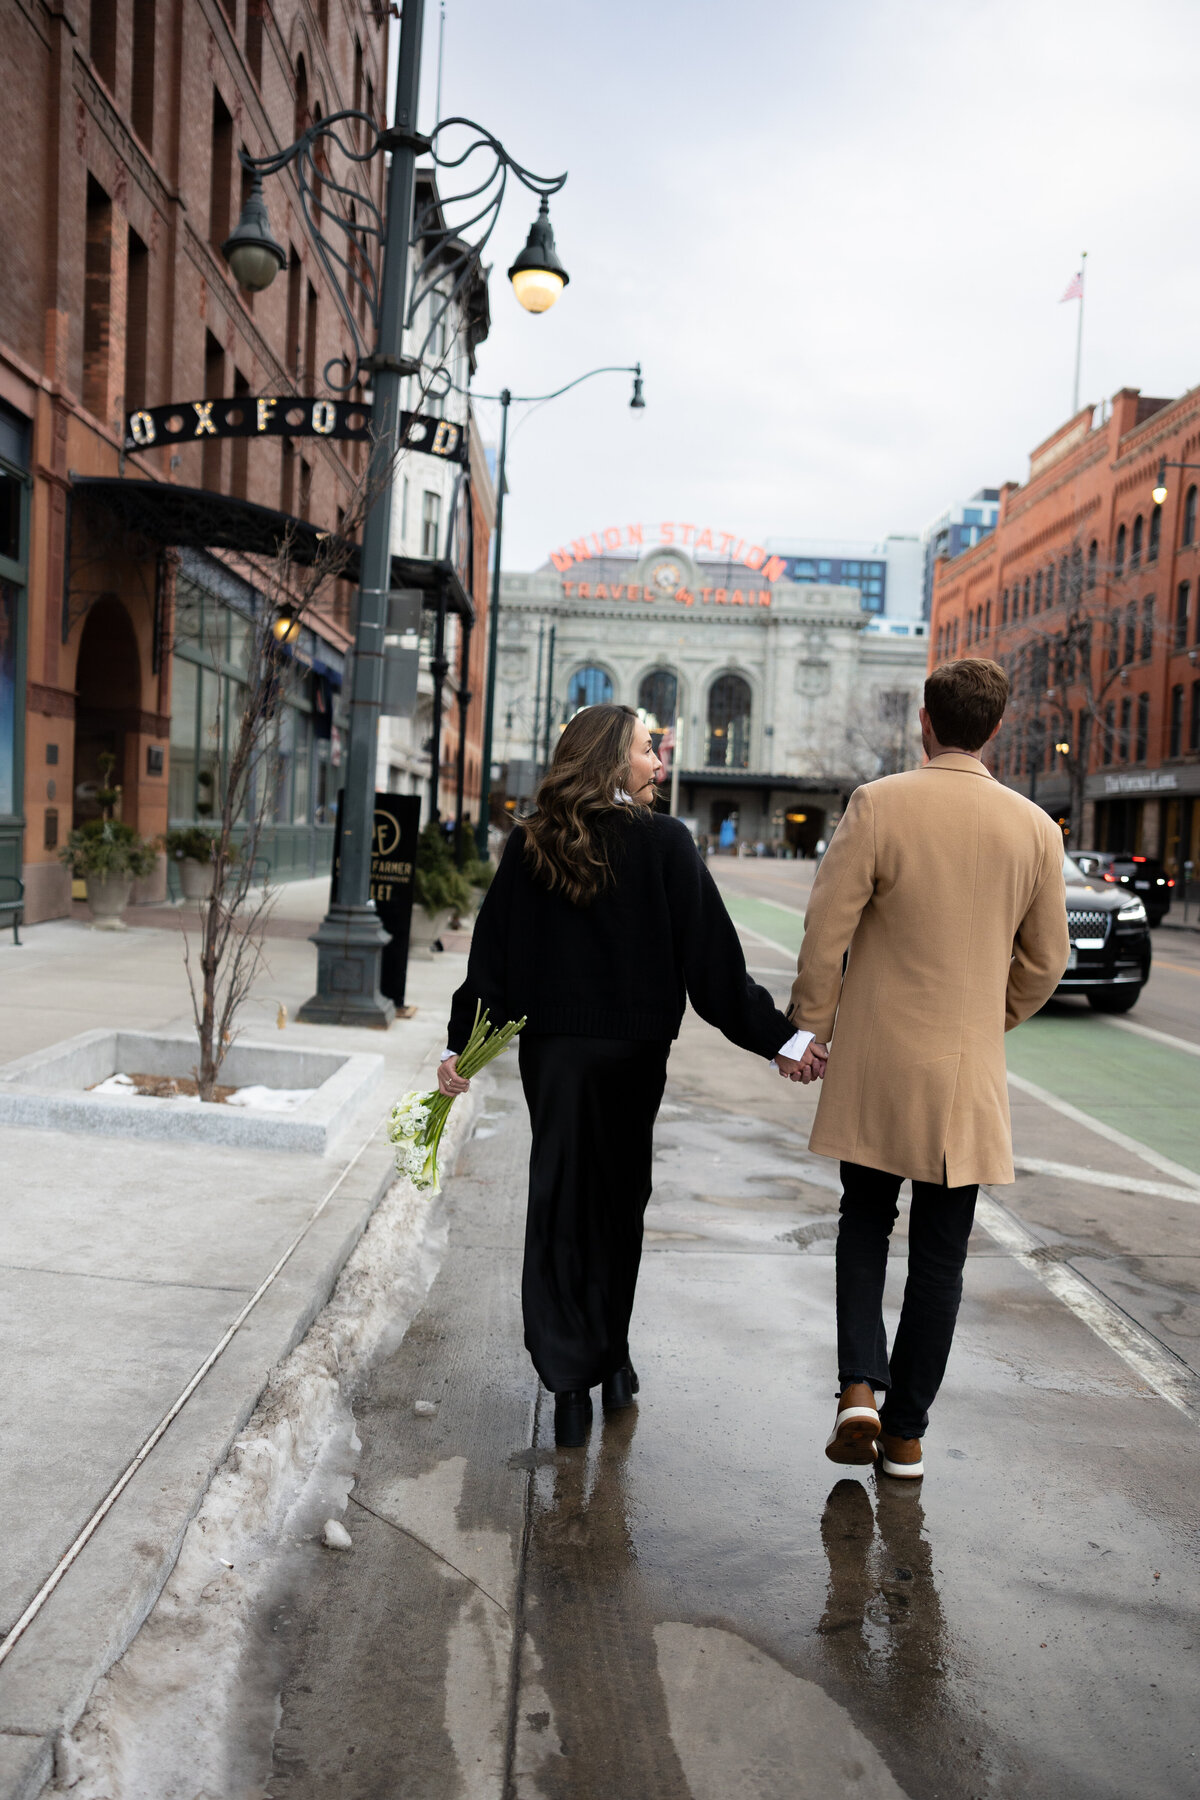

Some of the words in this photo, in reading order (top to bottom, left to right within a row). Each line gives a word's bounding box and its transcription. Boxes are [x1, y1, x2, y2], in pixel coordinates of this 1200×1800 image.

[129, 398, 459, 456] OXFOD
[550, 522, 644, 572] UNION
[659, 522, 787, 584] STATION
[562, 581, 656, 602] TRAVEL
[700, 587, 772, 607] TRAIN
[372, 860, 412, 875] FARMER
